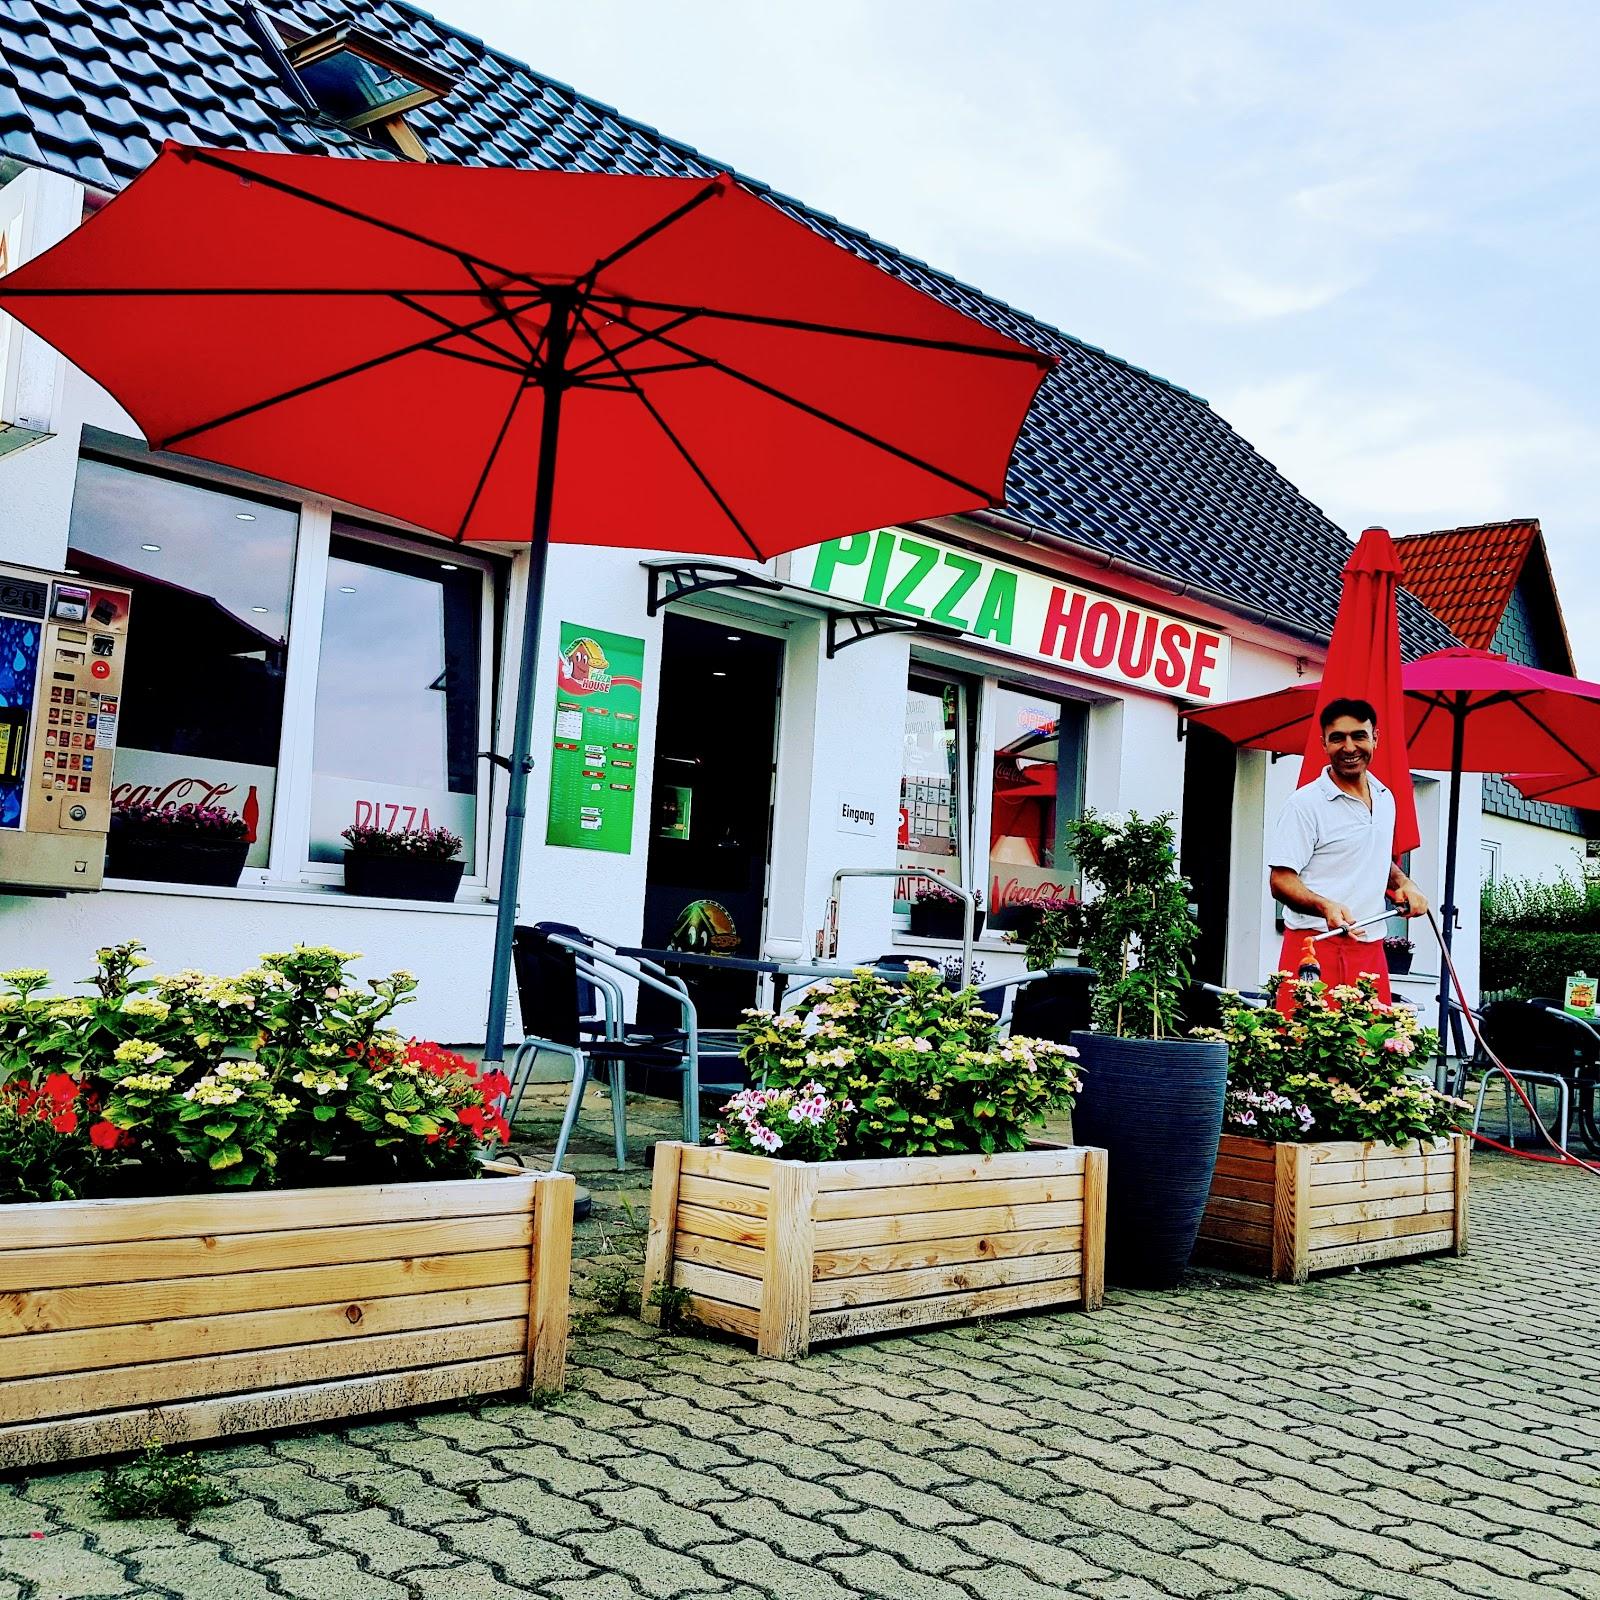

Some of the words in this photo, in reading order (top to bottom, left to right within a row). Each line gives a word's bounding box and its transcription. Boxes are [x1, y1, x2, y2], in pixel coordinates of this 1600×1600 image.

[810, 530, 1018, 646] PIZZA
[1039, 585, 1220, 698] HOUSE
[582, 679, 610, 692] HOUSE
[591, 672, 611, 683] PIZZA
[1018, 710, 1057, 734] OPEN
[842, 803, 875, 825] Eingang
